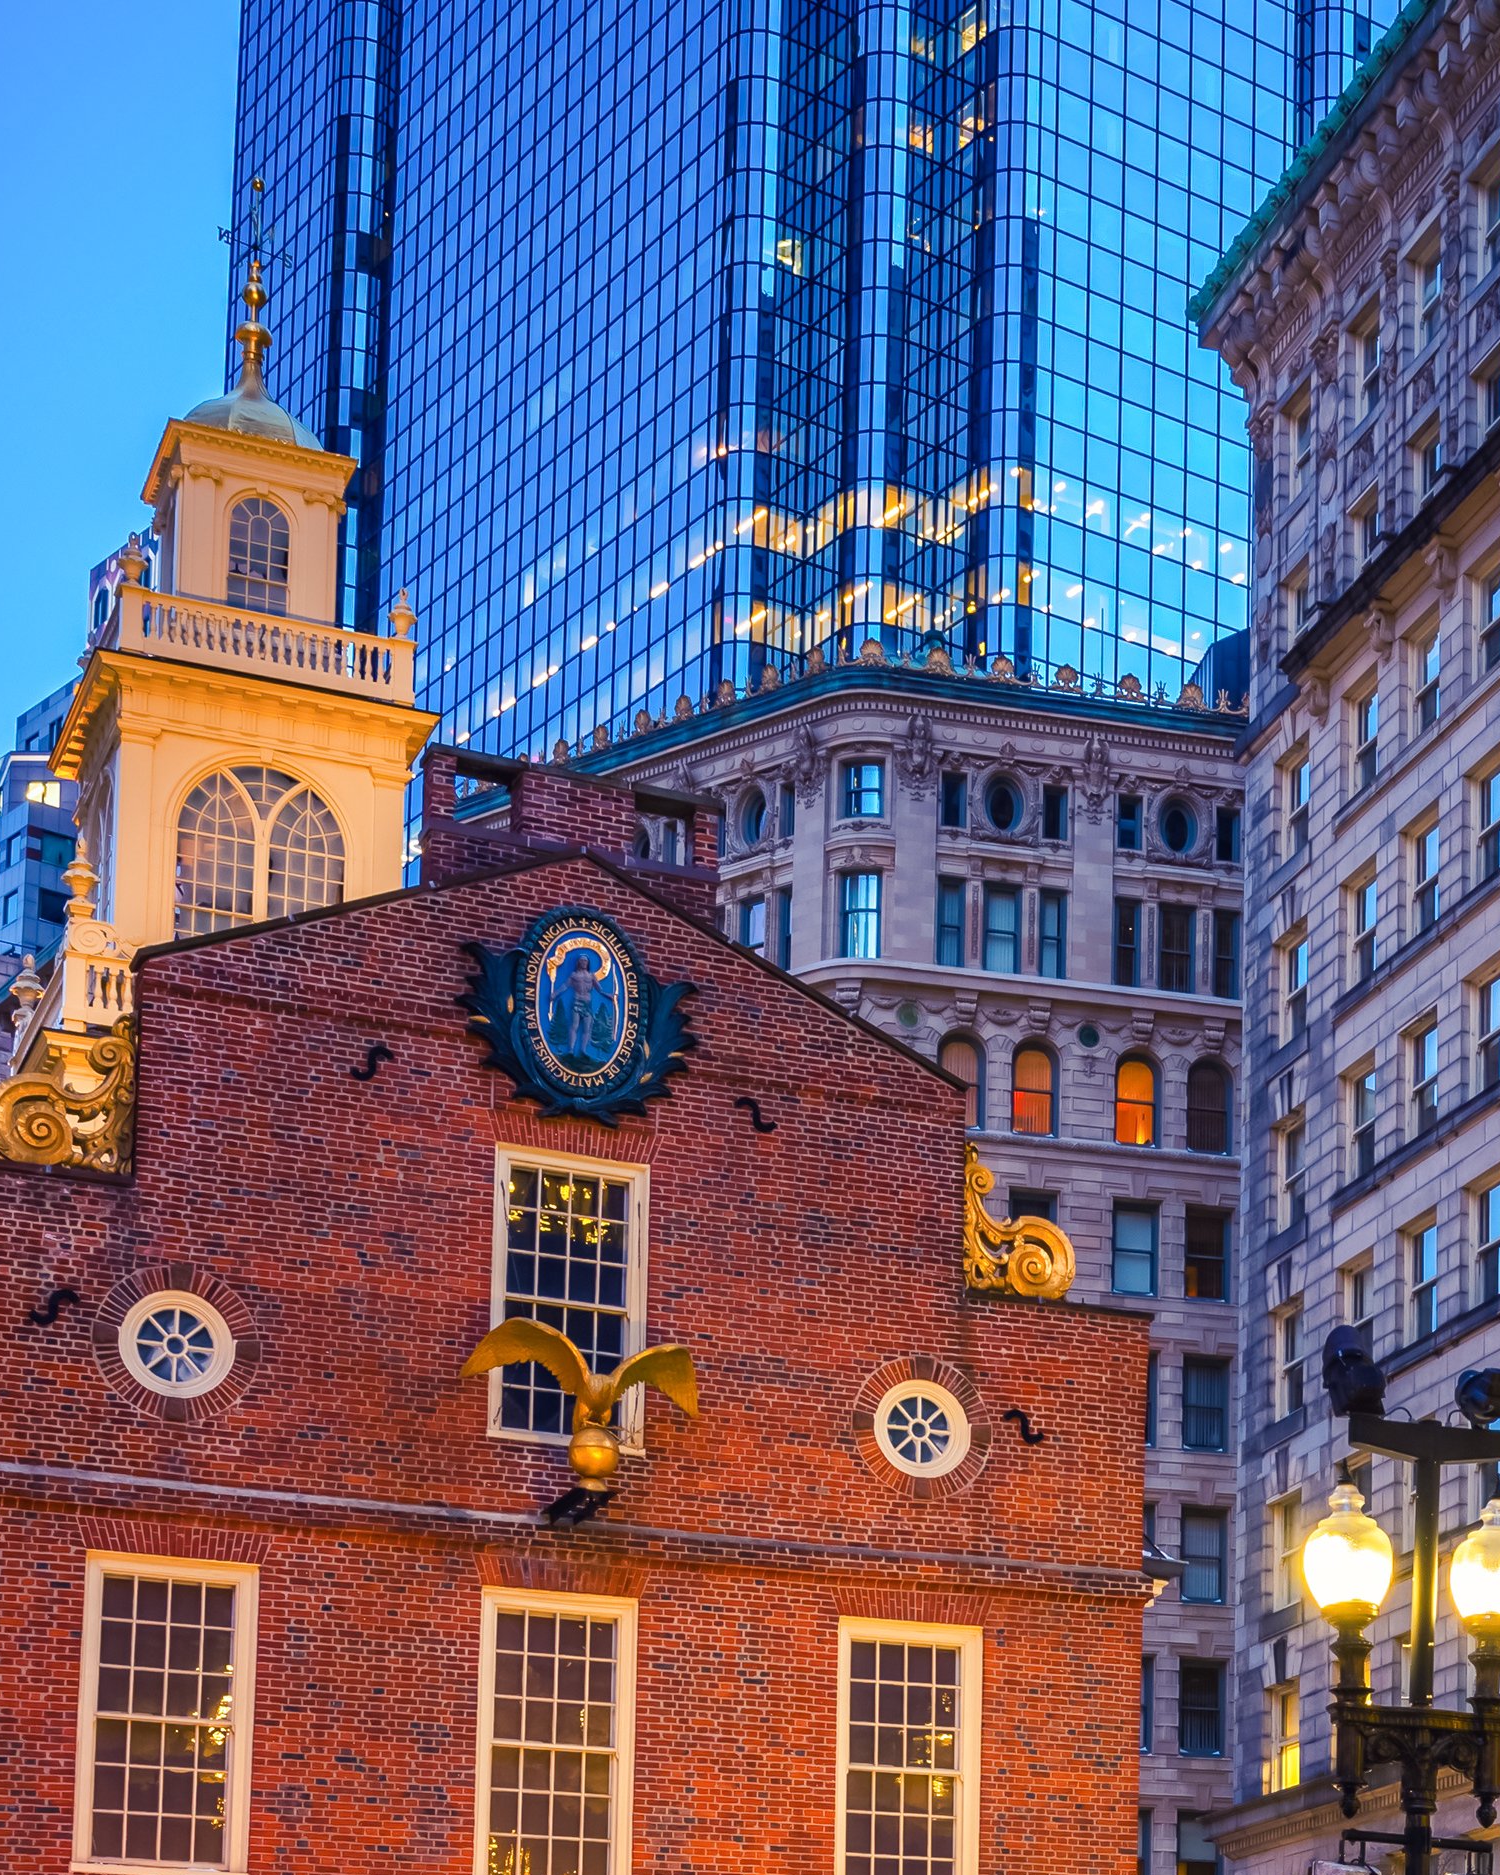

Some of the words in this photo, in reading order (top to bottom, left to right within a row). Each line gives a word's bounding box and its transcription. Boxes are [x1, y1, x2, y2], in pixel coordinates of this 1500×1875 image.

[526, 952, 542, 983] NOVA
[525, 987, 535, 1000] IN
[626, 972, 638, 998] CUM
[525, 1006, 537, 1029] BAY
[629, 1003, 639, 1018] ET
[618, 1021, 638, 1065] SOCIET
[604, 1063, 620, 1079] DE
